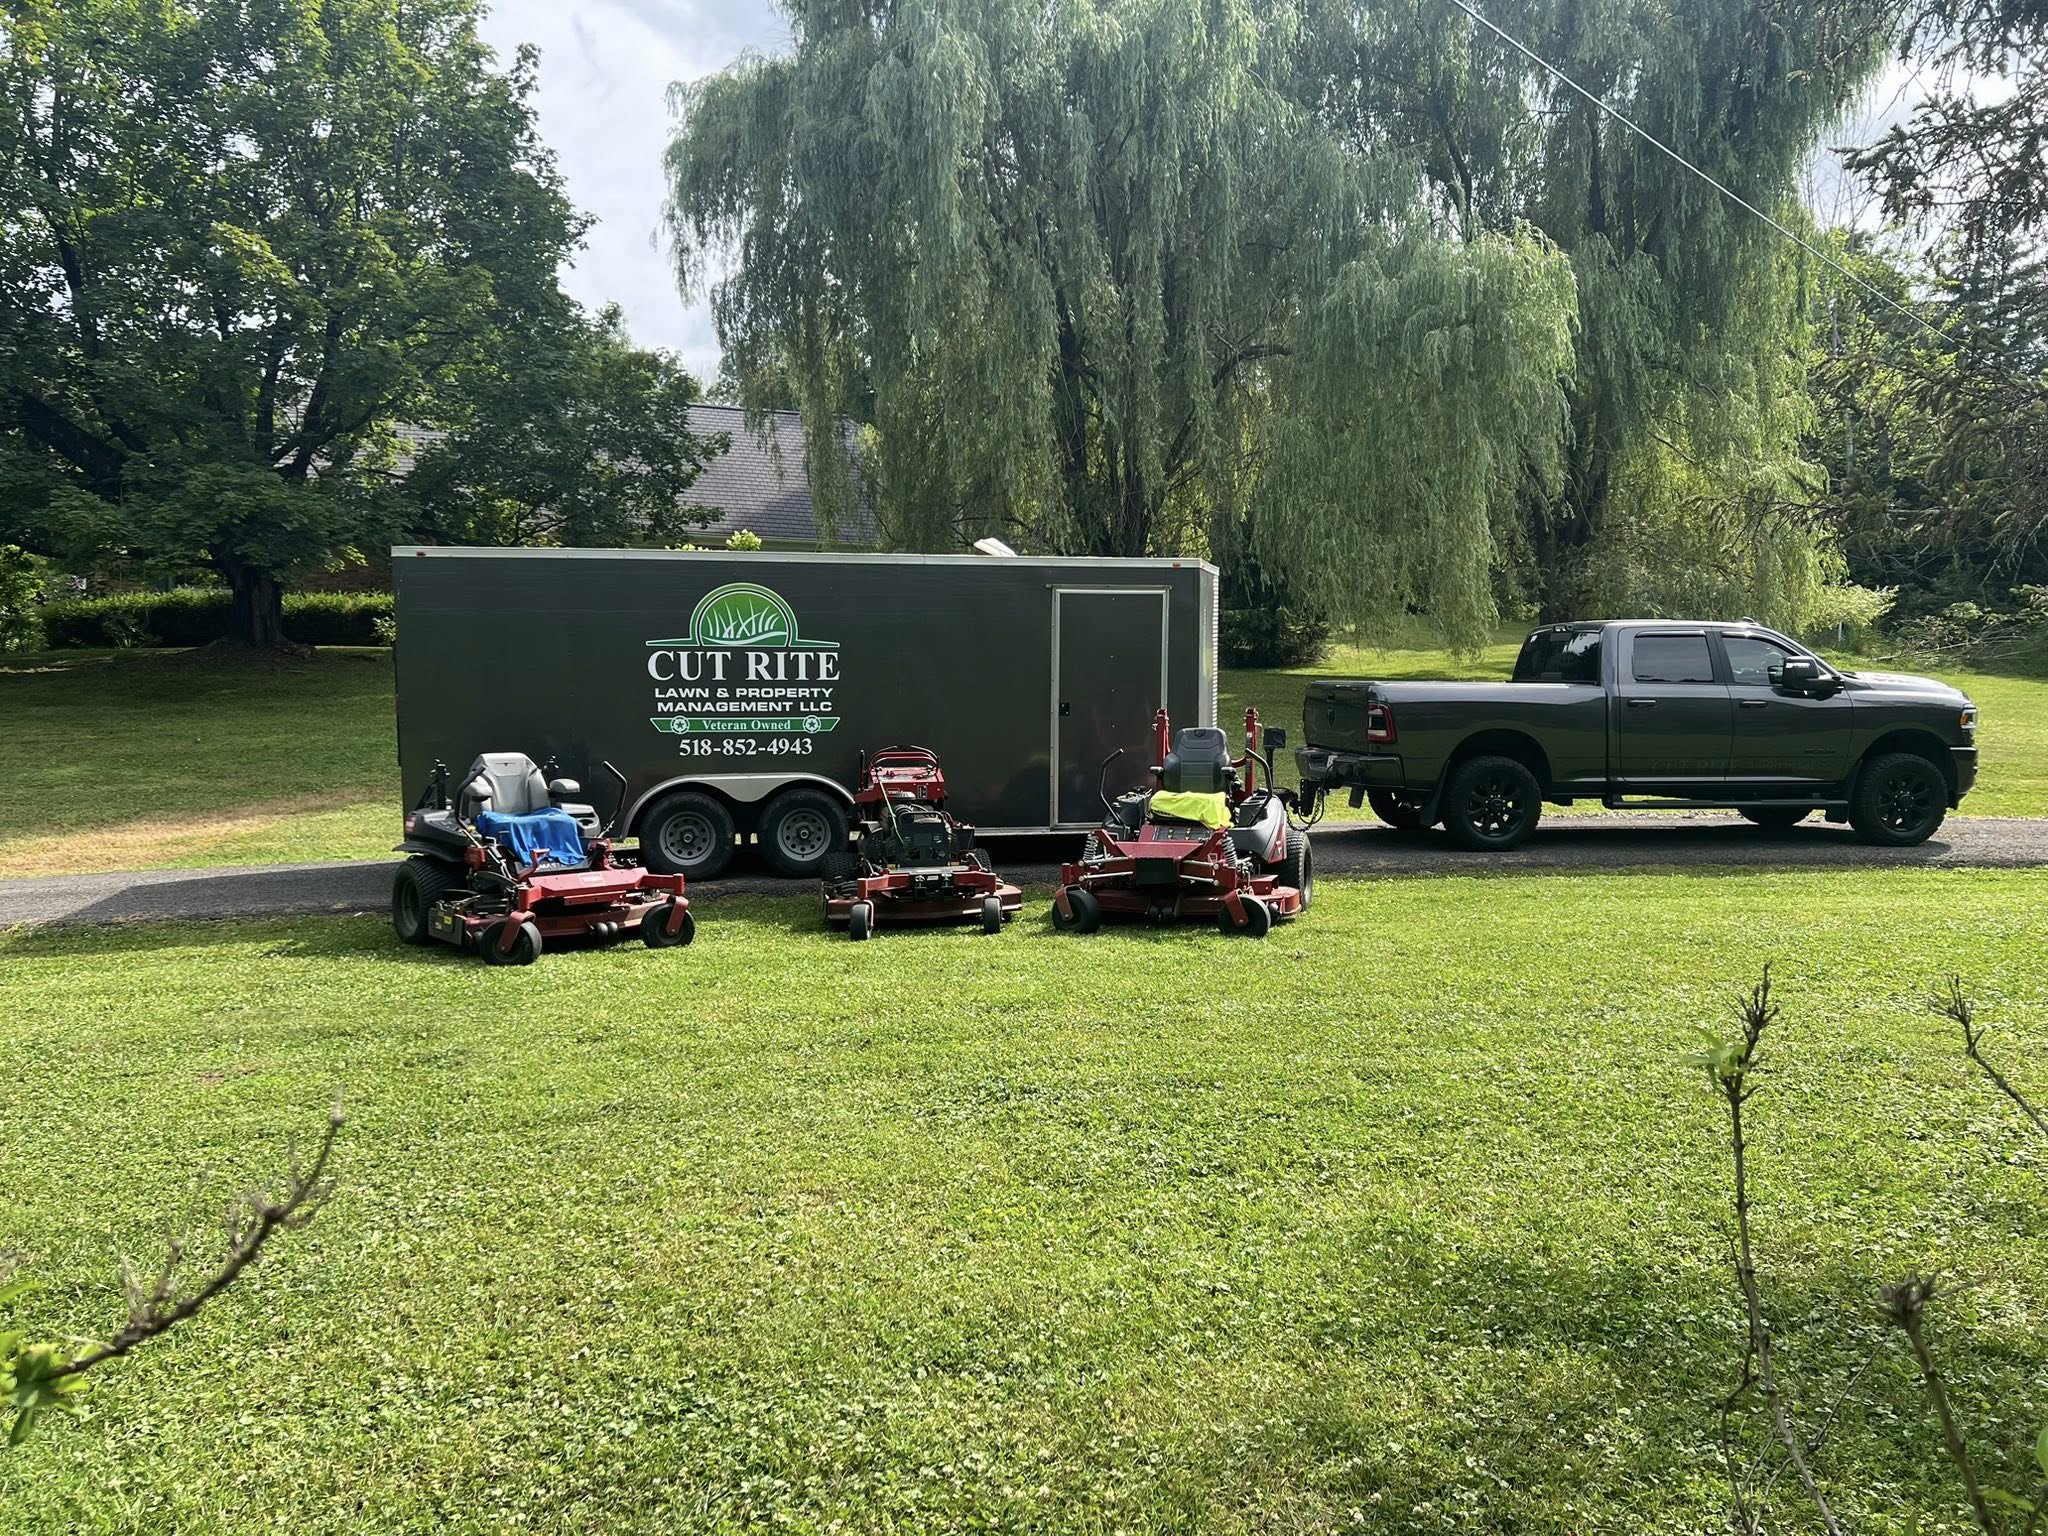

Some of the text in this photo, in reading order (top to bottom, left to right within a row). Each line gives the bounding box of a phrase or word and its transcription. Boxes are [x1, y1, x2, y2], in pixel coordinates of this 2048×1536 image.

[647, 650, 840, 681] CUT RITE
[654, 687, 834, 698] LAWN & PROPERTY
[657, 701, 833, 712] MANAGEMENT LLC
[702, 719, 791, 730] Veteran Owned
[679, 738, 813, 756] 518-852-4943
